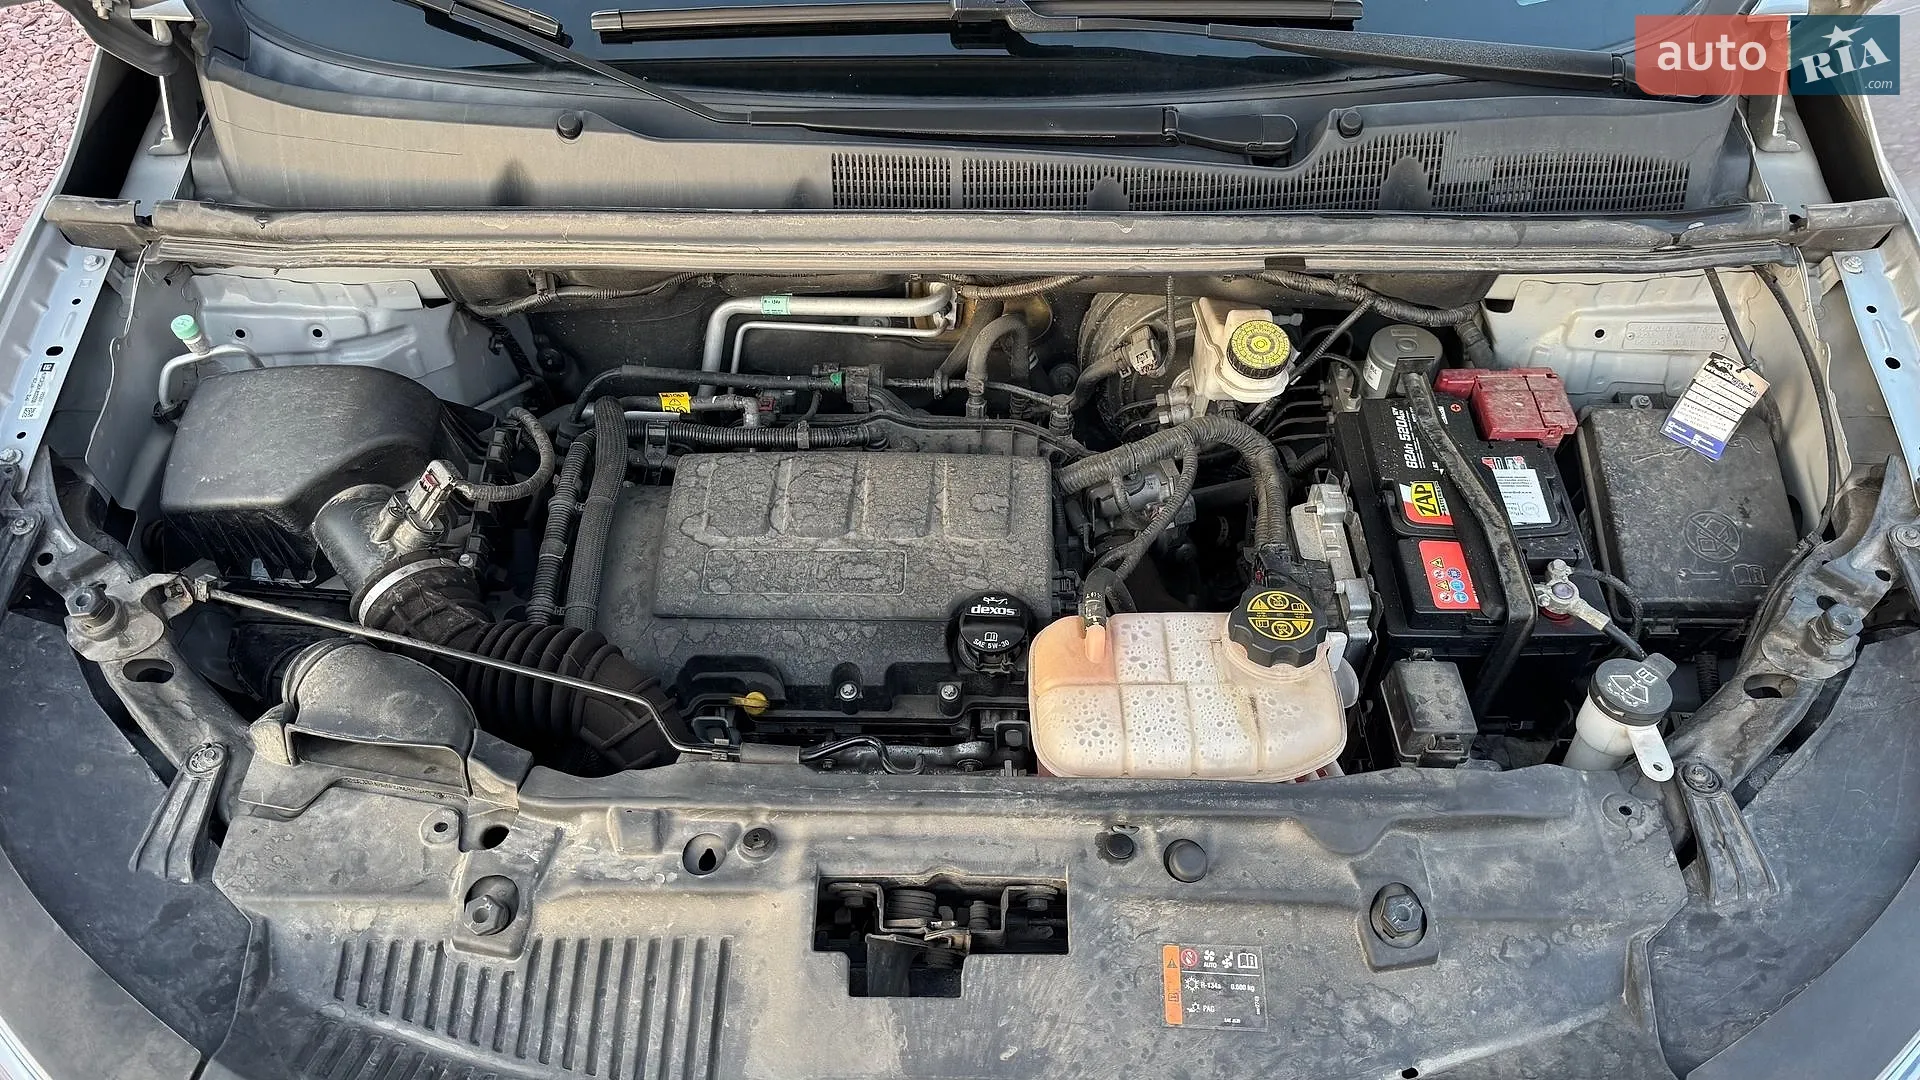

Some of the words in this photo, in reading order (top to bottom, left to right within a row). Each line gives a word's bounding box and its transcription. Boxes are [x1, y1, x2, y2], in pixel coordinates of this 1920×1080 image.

[1414, 484, 1438, 515] ZAP
[970, 604, 1015, 616] dexos
[972, 638, 986, 648] SAE
[987, 639, 1010, 649] 5W-30
